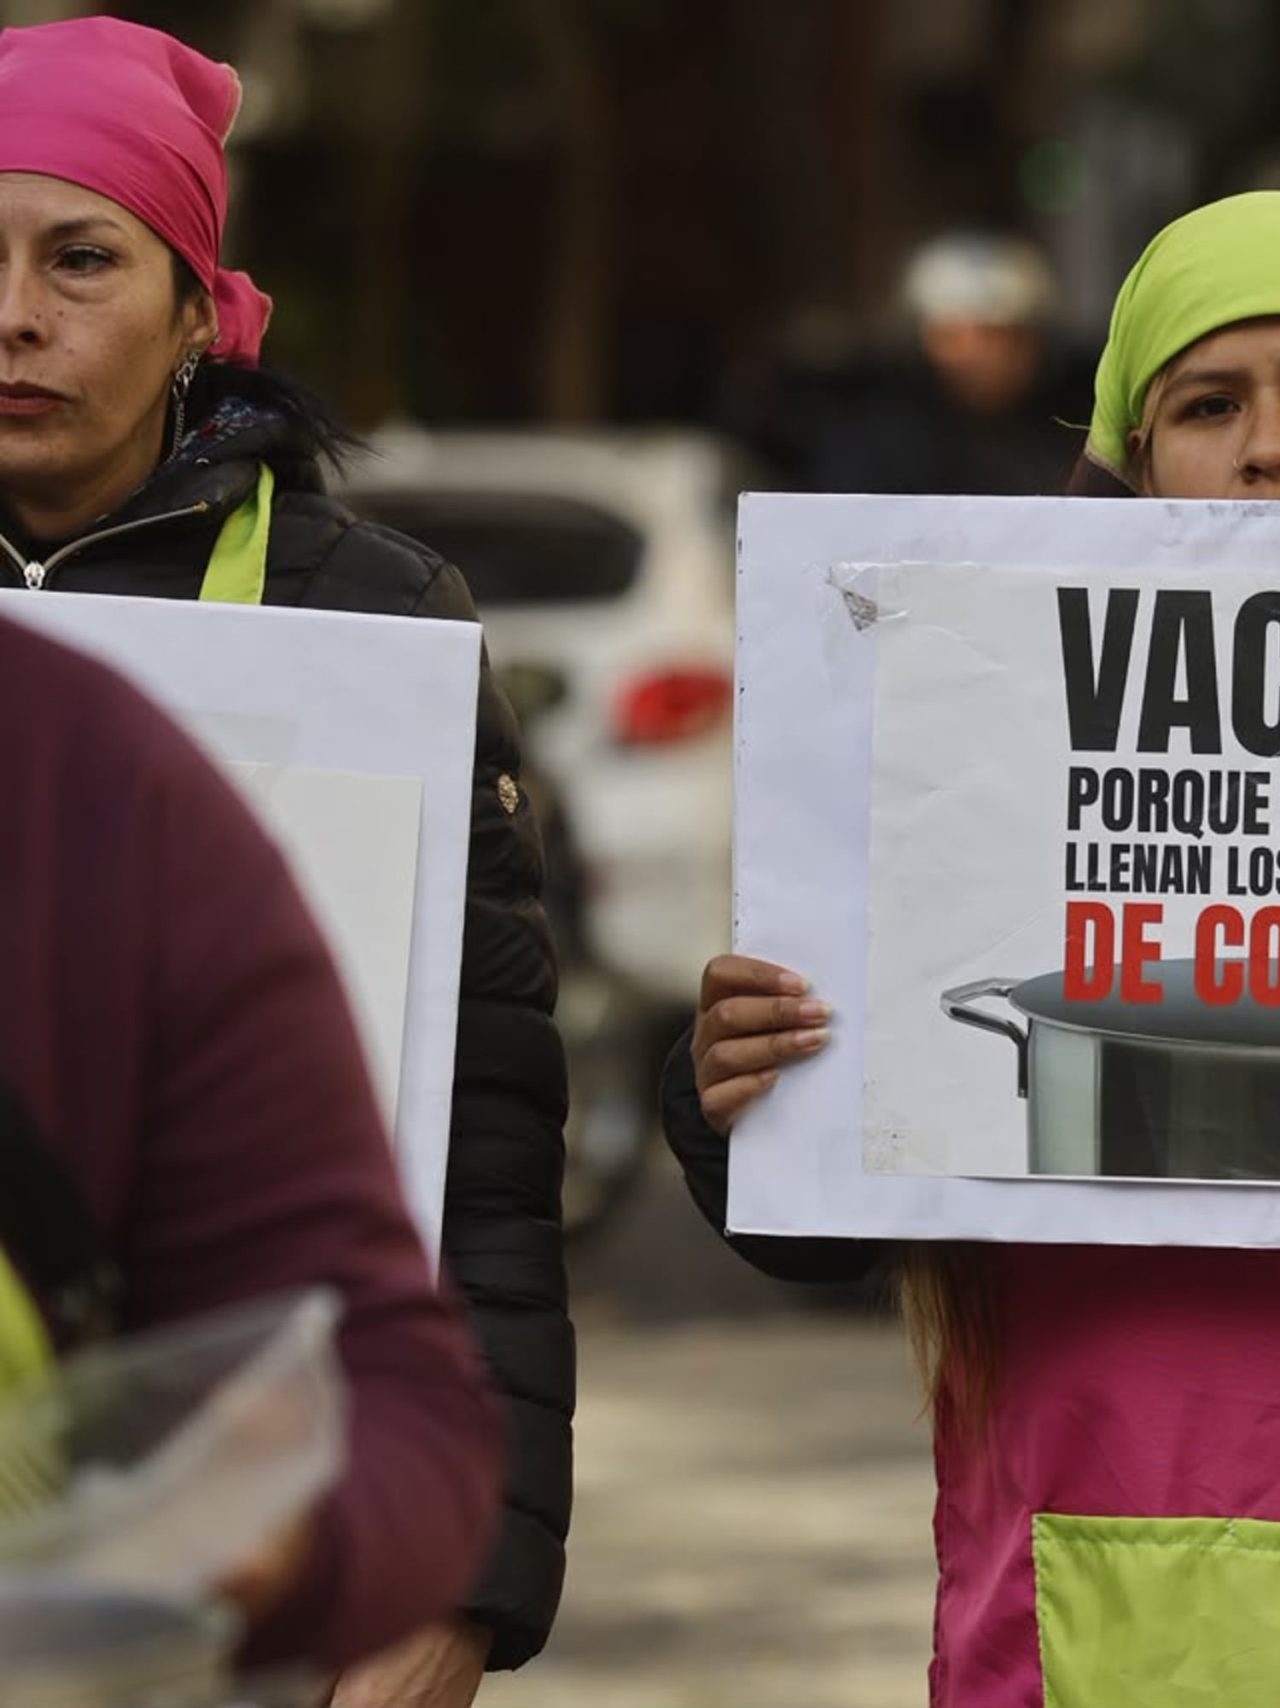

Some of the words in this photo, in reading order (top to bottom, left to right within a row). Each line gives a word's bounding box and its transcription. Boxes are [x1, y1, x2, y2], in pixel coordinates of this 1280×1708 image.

[1066, 766, 1271, 838] PORQUE
[1065, 842, 1212, 895] LLENAN
[1063, 901, 1163, 1005] DE
